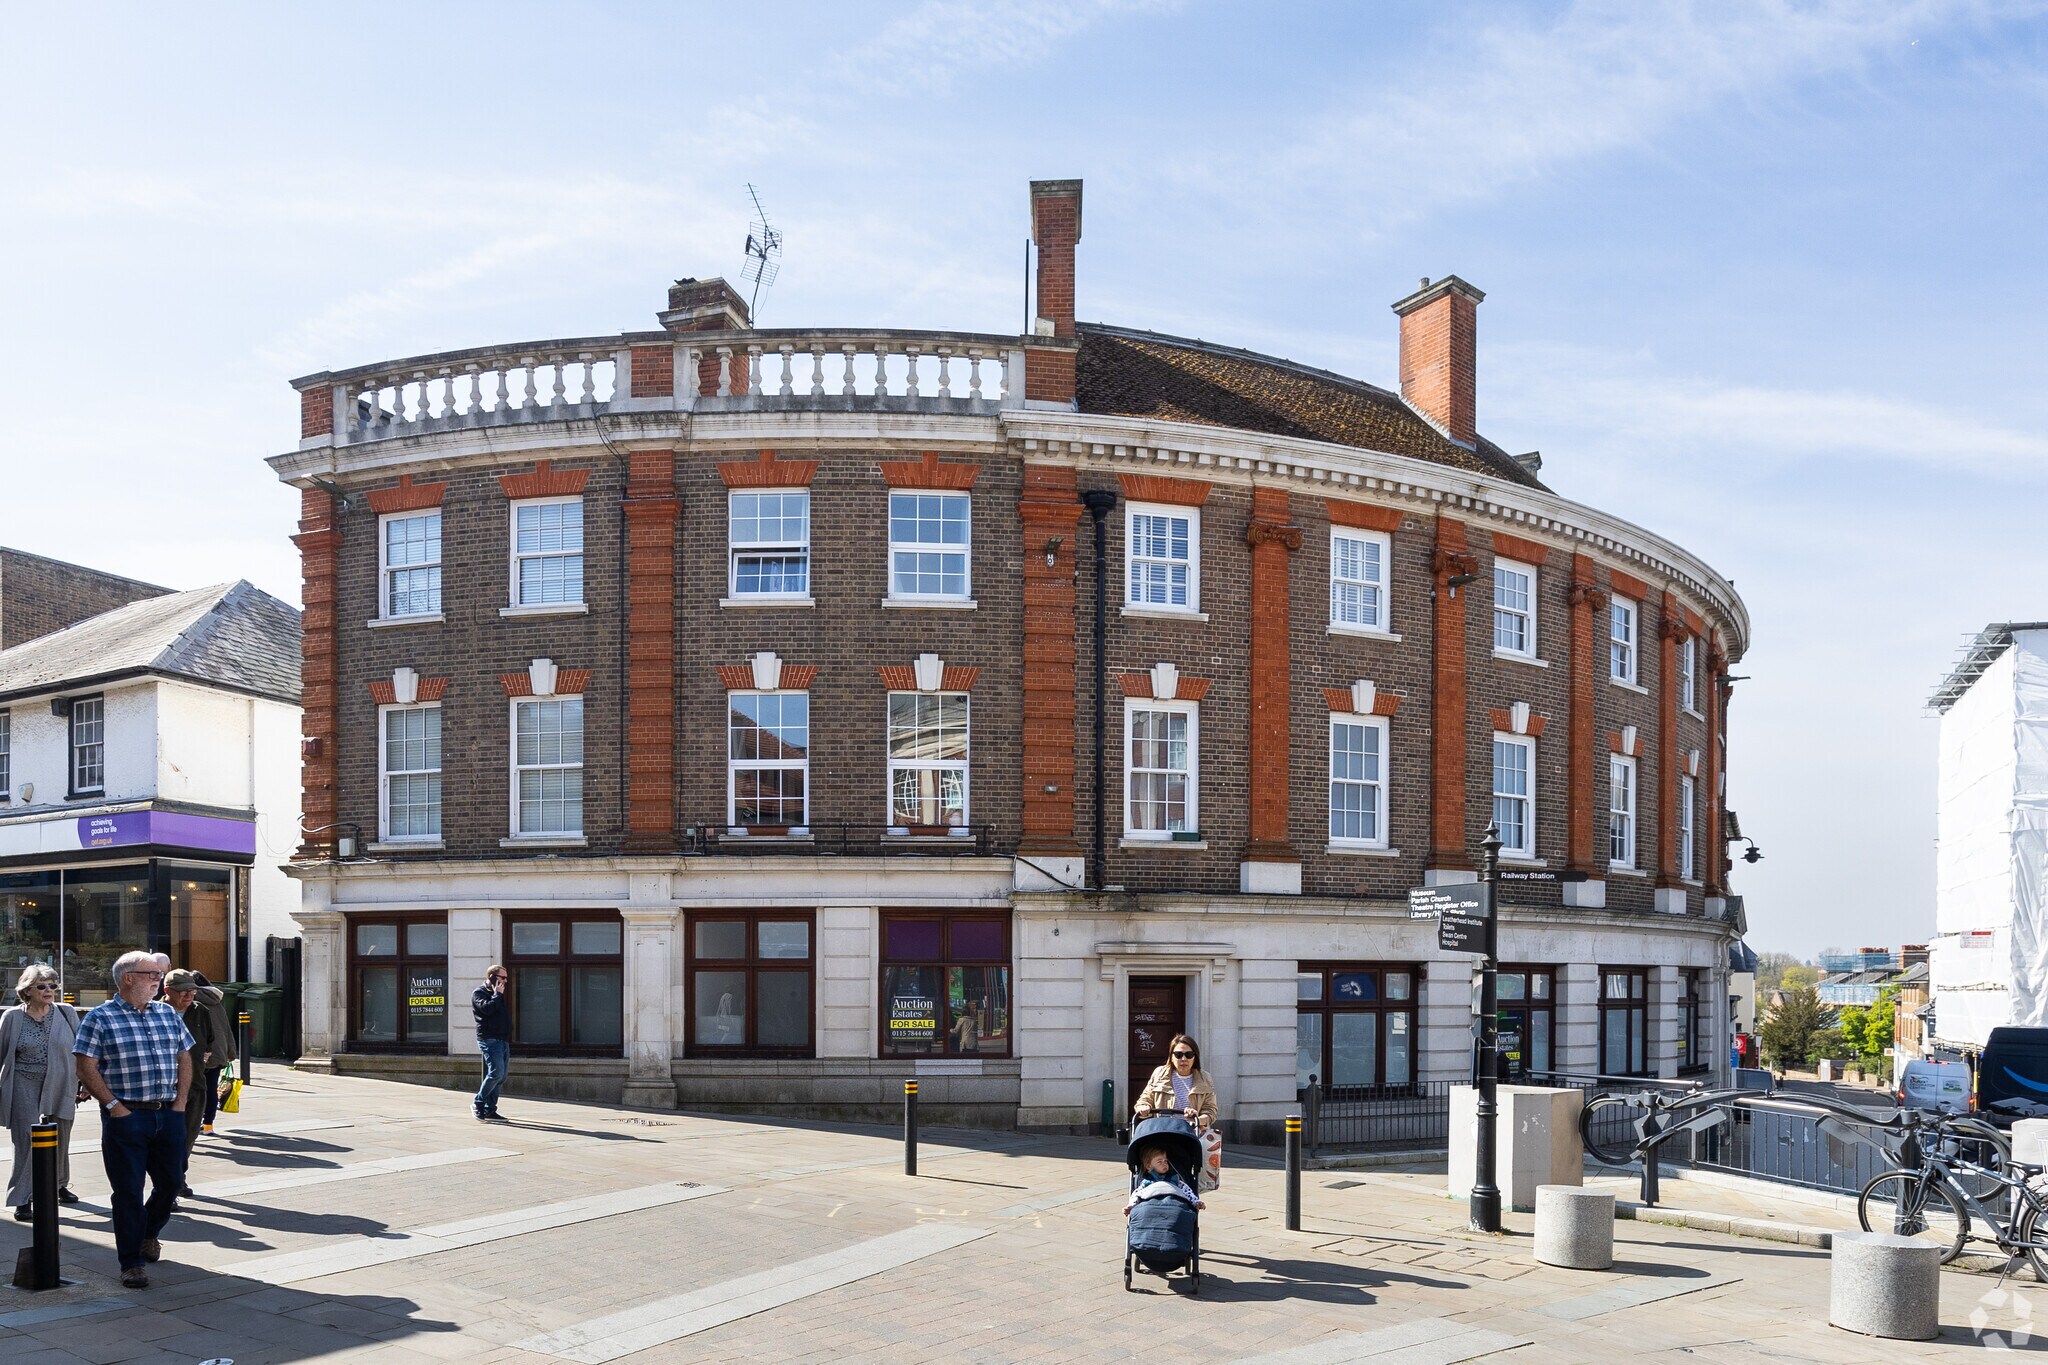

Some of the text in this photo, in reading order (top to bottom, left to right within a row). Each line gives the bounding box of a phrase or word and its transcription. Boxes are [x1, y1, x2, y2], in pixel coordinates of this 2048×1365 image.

[91, 828, 103, 836] goals
[1501, 872, 1528, 880] Railway
[1434, 902, 1459, 910] Register
[1442, 915, 1482, 926] Leatherhead Institute
[1454, 932, 1467, 940] Centre
[1441, 939, 1458, 947] Hospital
[411, 977, 442, 987] Auction
[893, 999, 933, 1008] Auction
[892, 1010, 922, 1018] Estates
